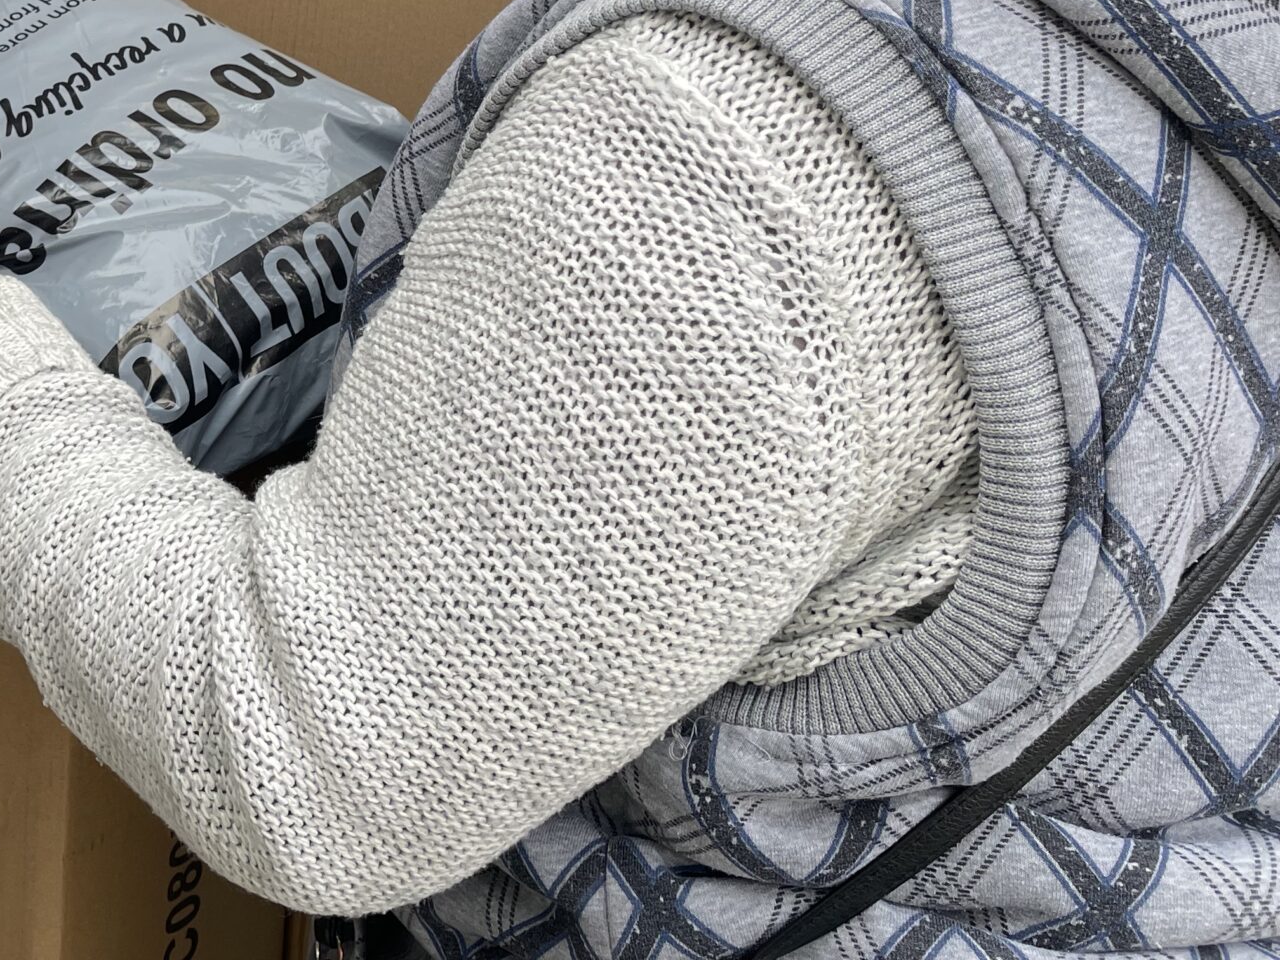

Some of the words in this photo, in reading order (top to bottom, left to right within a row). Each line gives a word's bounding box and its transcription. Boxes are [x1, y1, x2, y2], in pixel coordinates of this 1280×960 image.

[156, 22, 187, 44] a
[209, 49, 317, 101] no
[0, 36, 161, 138] recycling
[229, 187, 378, 357] BOUT
[117, 311, 234, 425] YO
